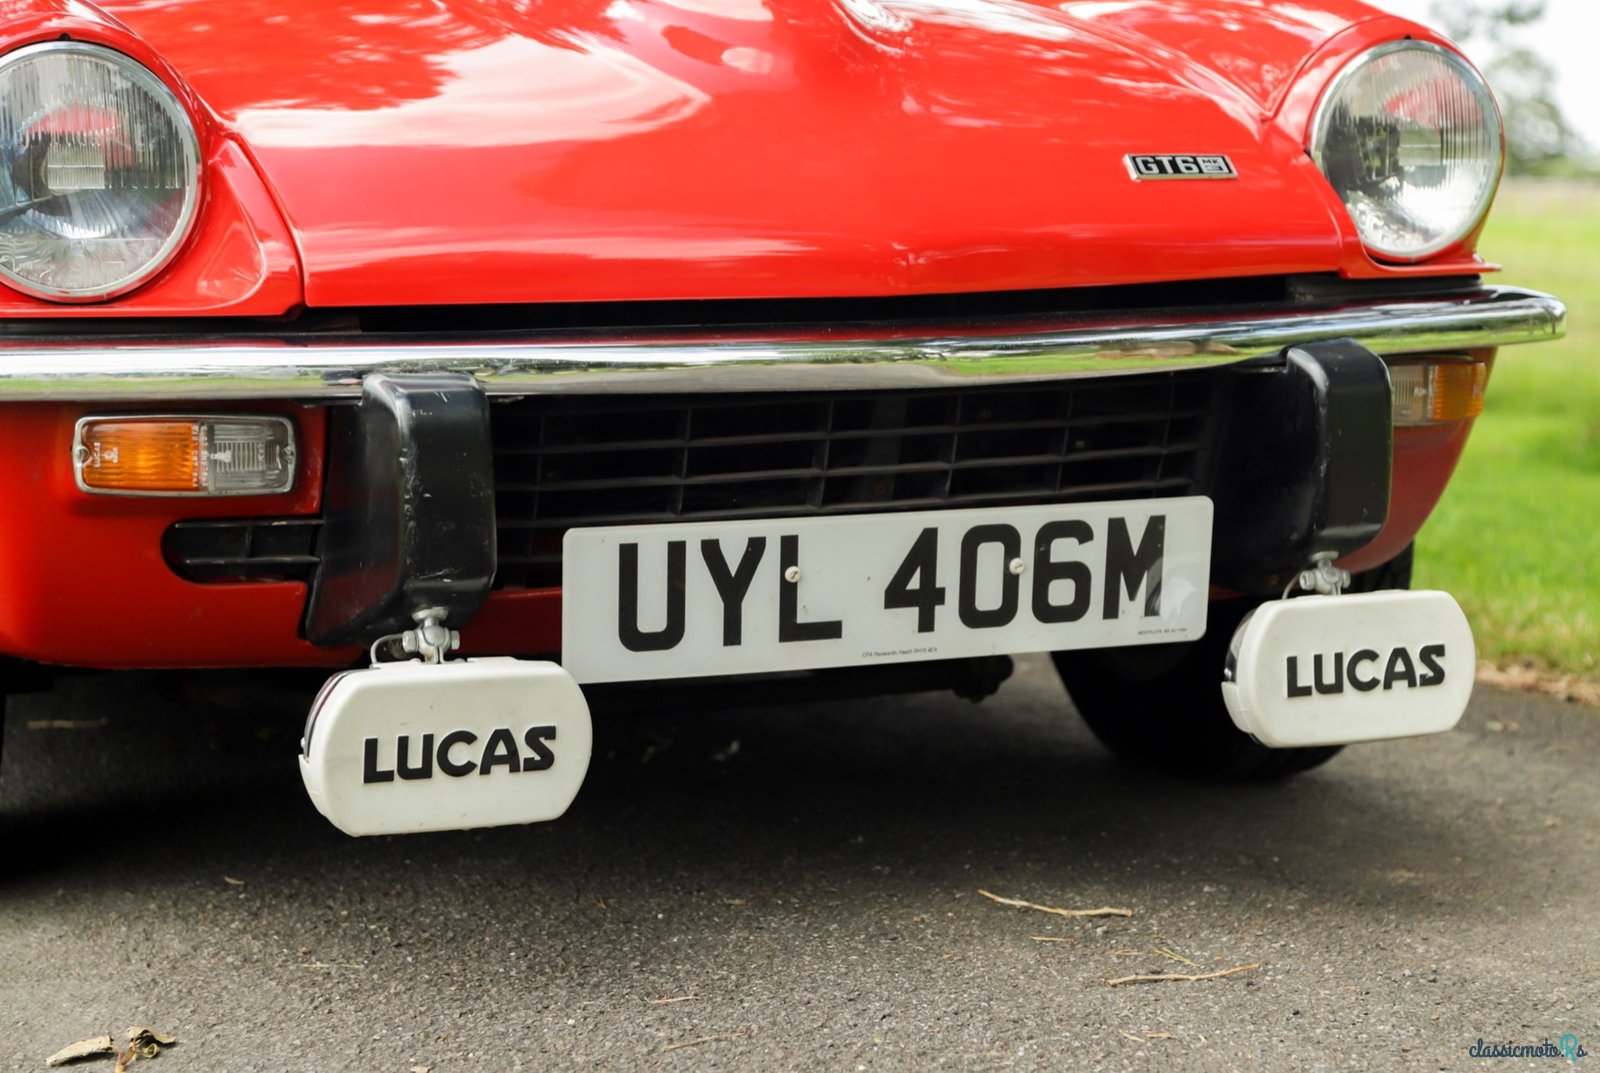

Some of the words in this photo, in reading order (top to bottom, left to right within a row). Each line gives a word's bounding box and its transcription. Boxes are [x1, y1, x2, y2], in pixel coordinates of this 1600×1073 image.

[1135, 156, 1200, 174] GT6
[619, 535, 843, 653] UYL
[884, 515, 1166, 634] 406M
[1286, 644, 1446, 699] LUCAS
[363, 725, 557, 784] LUCAS
